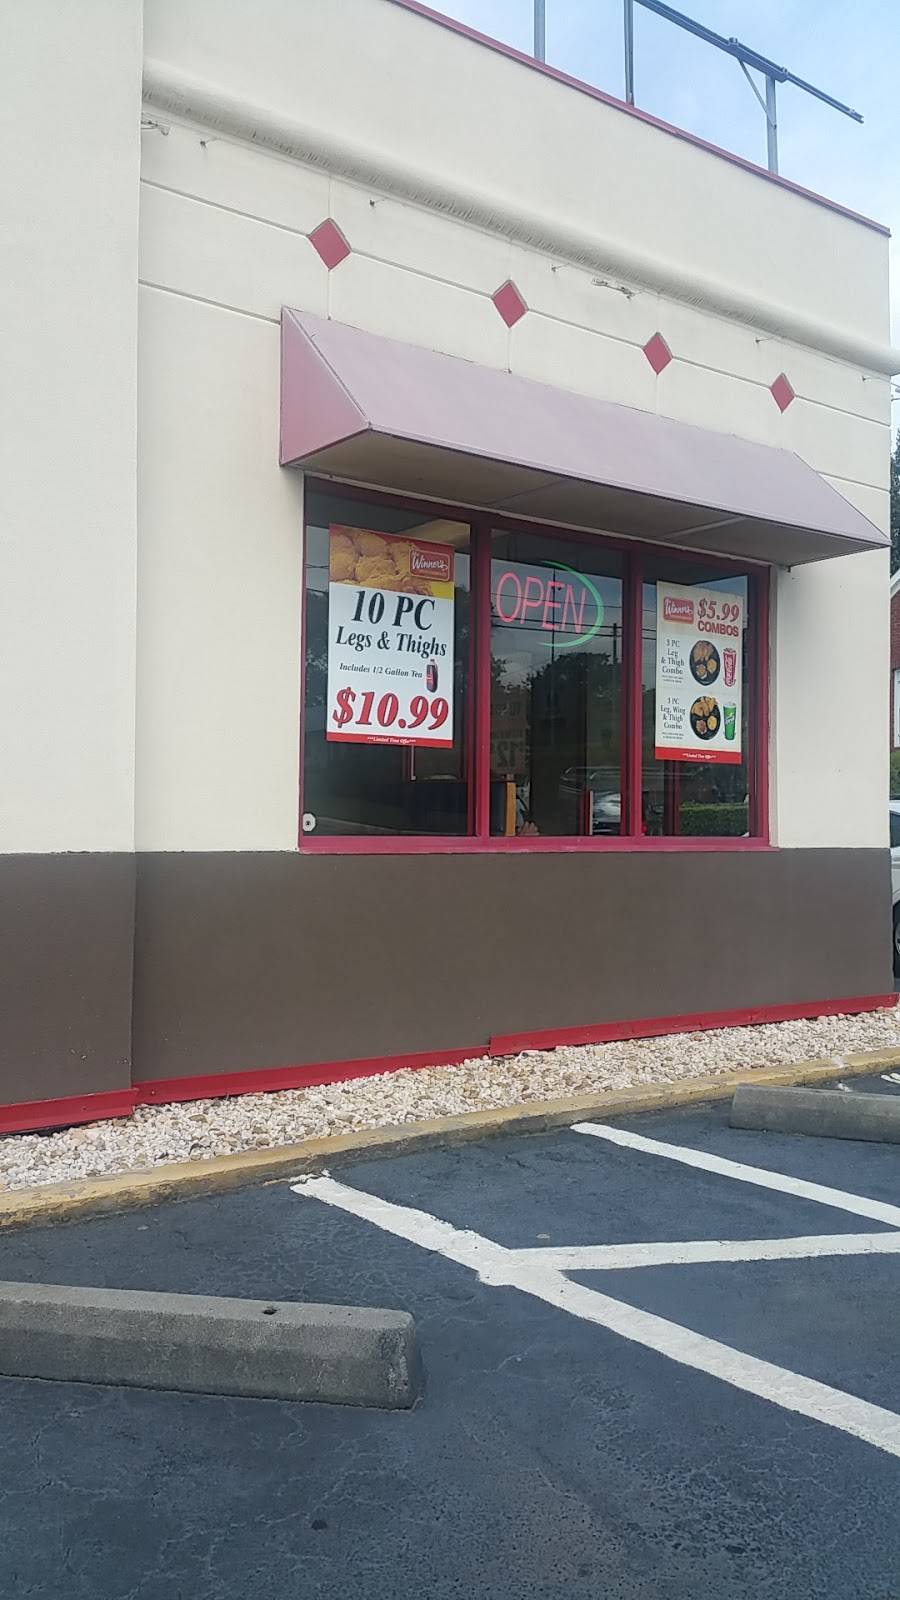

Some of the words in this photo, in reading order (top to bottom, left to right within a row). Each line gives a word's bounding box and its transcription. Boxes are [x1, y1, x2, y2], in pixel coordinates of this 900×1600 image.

[352, 591, 385, 625] 10
[392, 596, 436, 631] PC
[496, 571, 586, 634] OPEN
[697, 598, 740, 622] $5.99
[698, 621, 739, 637] COMBOS
[336, 626, 373, 652] Legs
[377, 630, 391, 650] &
[396, 632, 447, 659] Thighs
[667, 648, 679, 659] Leg
[668, 657, 685, 668] Thigh
[339, 662, 371, 673] Includes
[372, 665, 383, 675] 1/2
[384, 667, 409, 677] Gallon
[411, 669, 423, 678] Tea
[662, 665, 683, 675] Combo
[332, 686, 449, 731] $10.99
